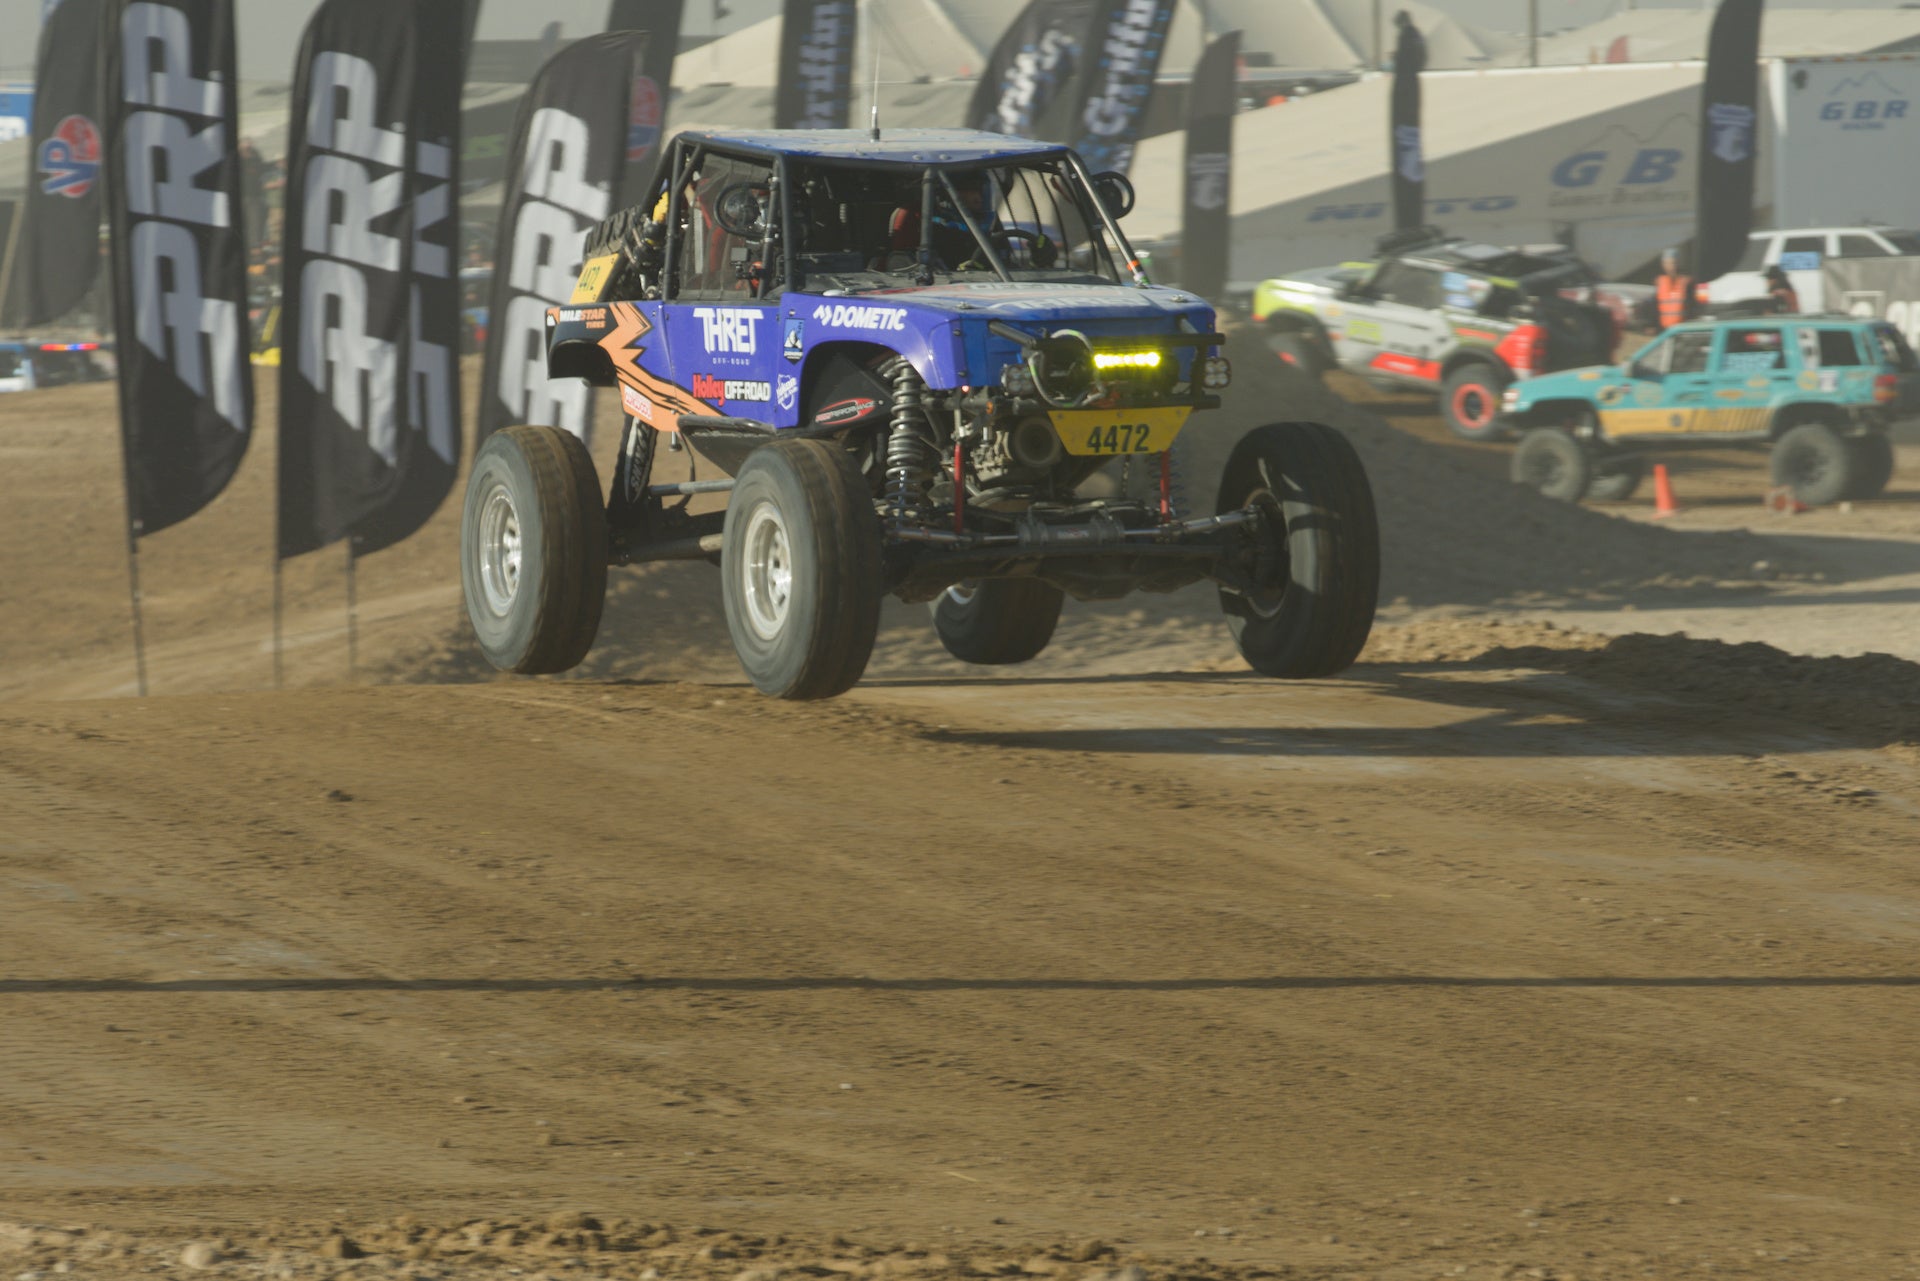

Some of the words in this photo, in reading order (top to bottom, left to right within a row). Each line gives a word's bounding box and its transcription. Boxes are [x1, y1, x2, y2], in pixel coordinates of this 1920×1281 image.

[120, 2, 245, 431] PRP
[300, 50, 406, 467] PRP
[560, 308, 607, 322] MILESTAR
[831, 305, 908, 331] DOMETIC
[693, 308, 764, 355] THRET
[712, 357, 750, 366] OFF-ROAD
[724, 381, 771, 401] OFF-ROAD
[1087, 424, 1150, 452] 4472
